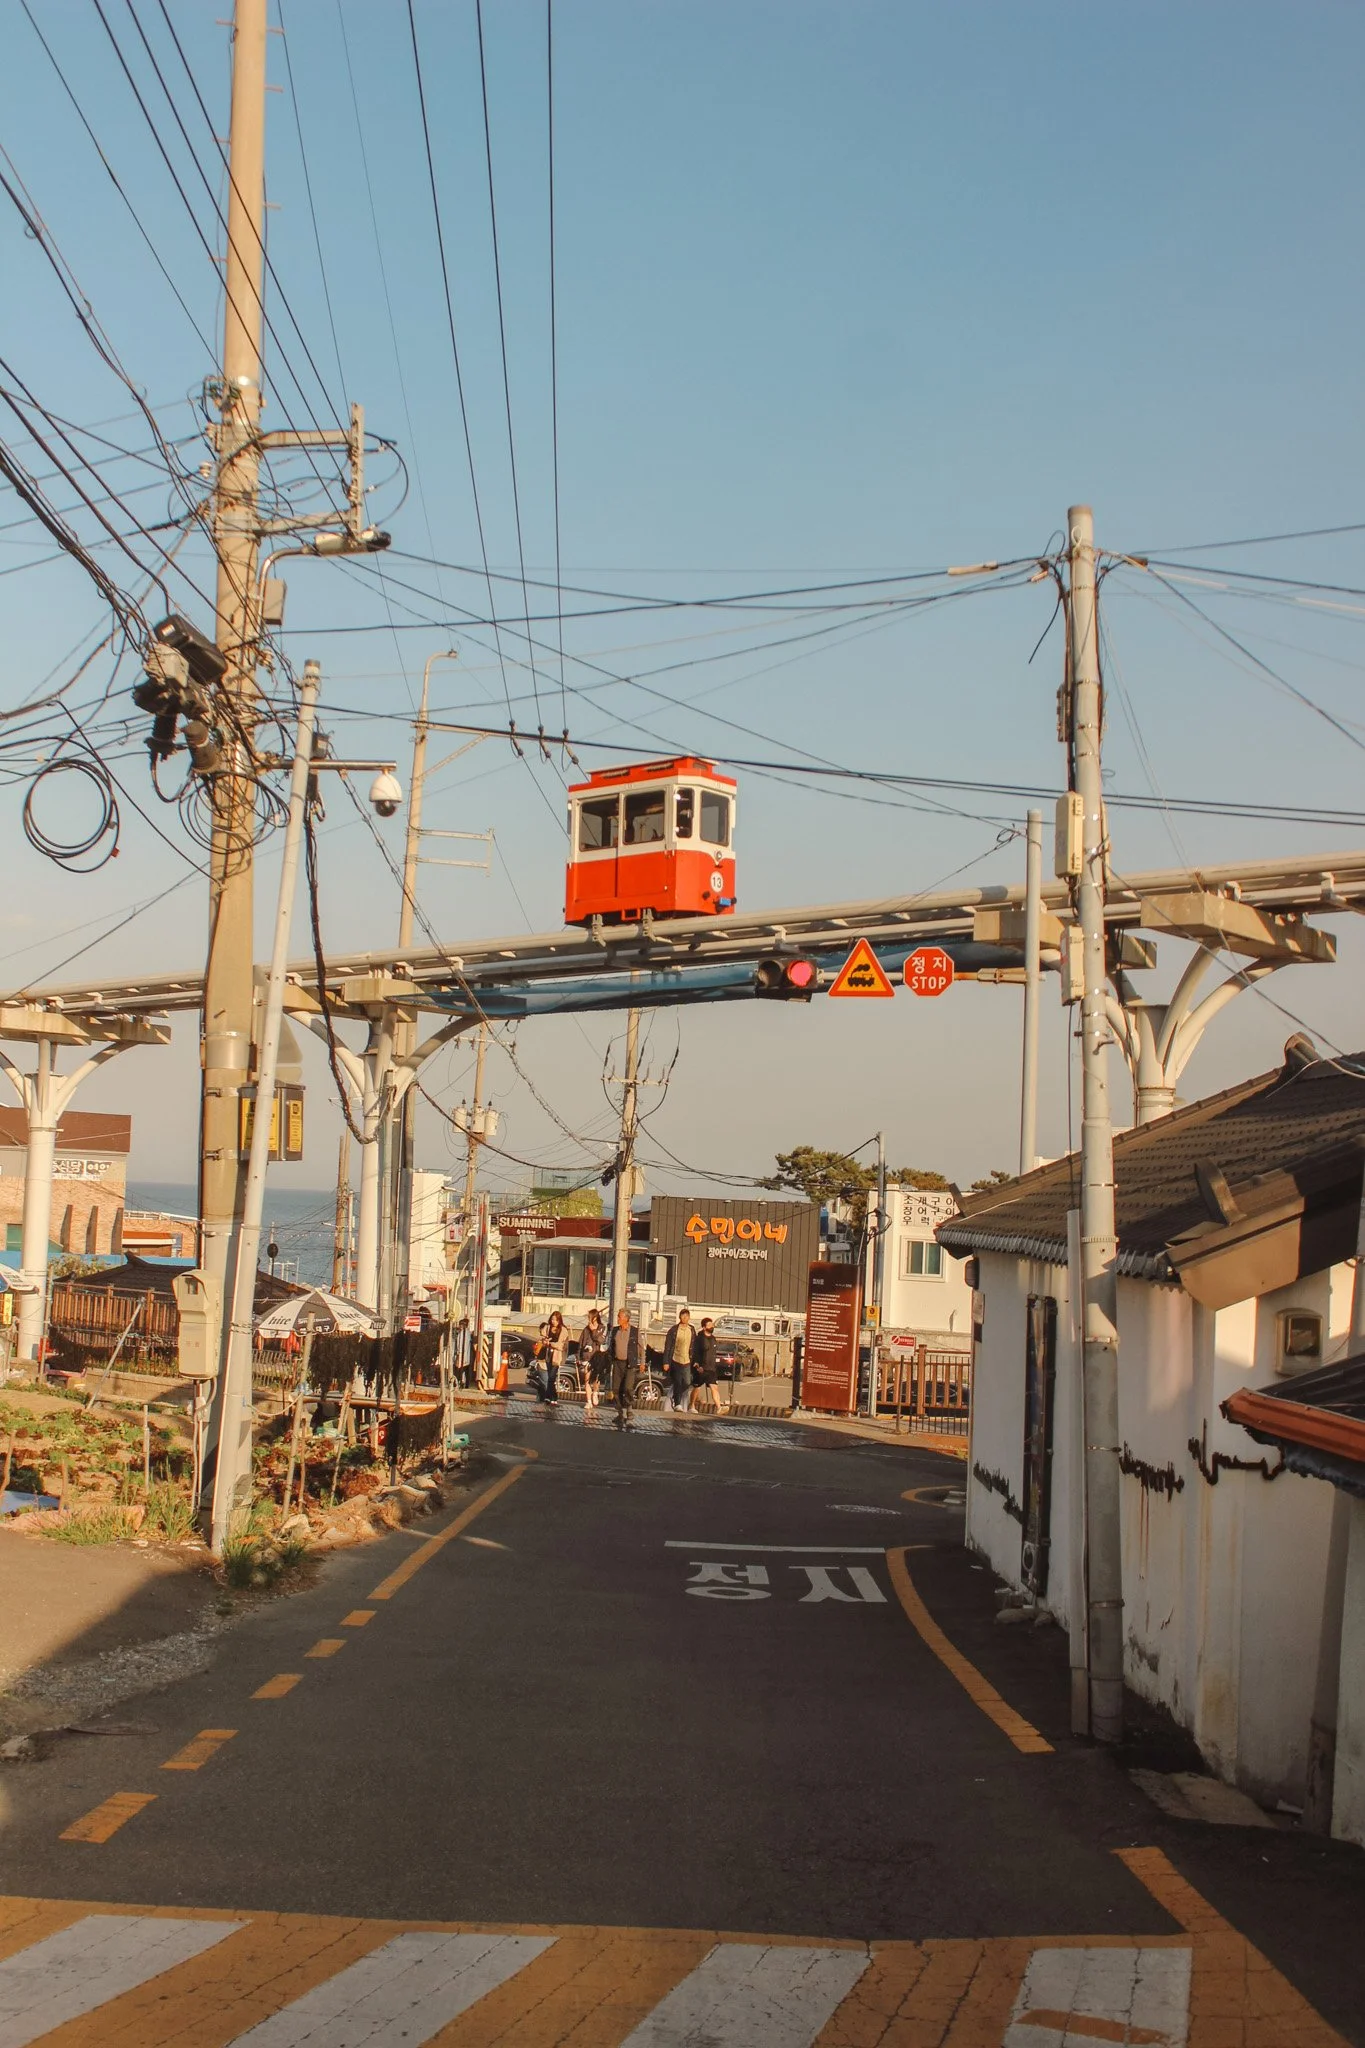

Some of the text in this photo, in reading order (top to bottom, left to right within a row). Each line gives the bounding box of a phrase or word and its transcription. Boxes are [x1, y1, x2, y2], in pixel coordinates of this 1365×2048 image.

[712, 876, 722, 888] 13
[911, 956, 947, 974] 정지
[911, 976, 947, 990] STOP
[499, 1216, 555, 1230] SUMININE
[684, 1213, 788, 1244] 수민이네
[685, 1561, 889, 1603] 정지
